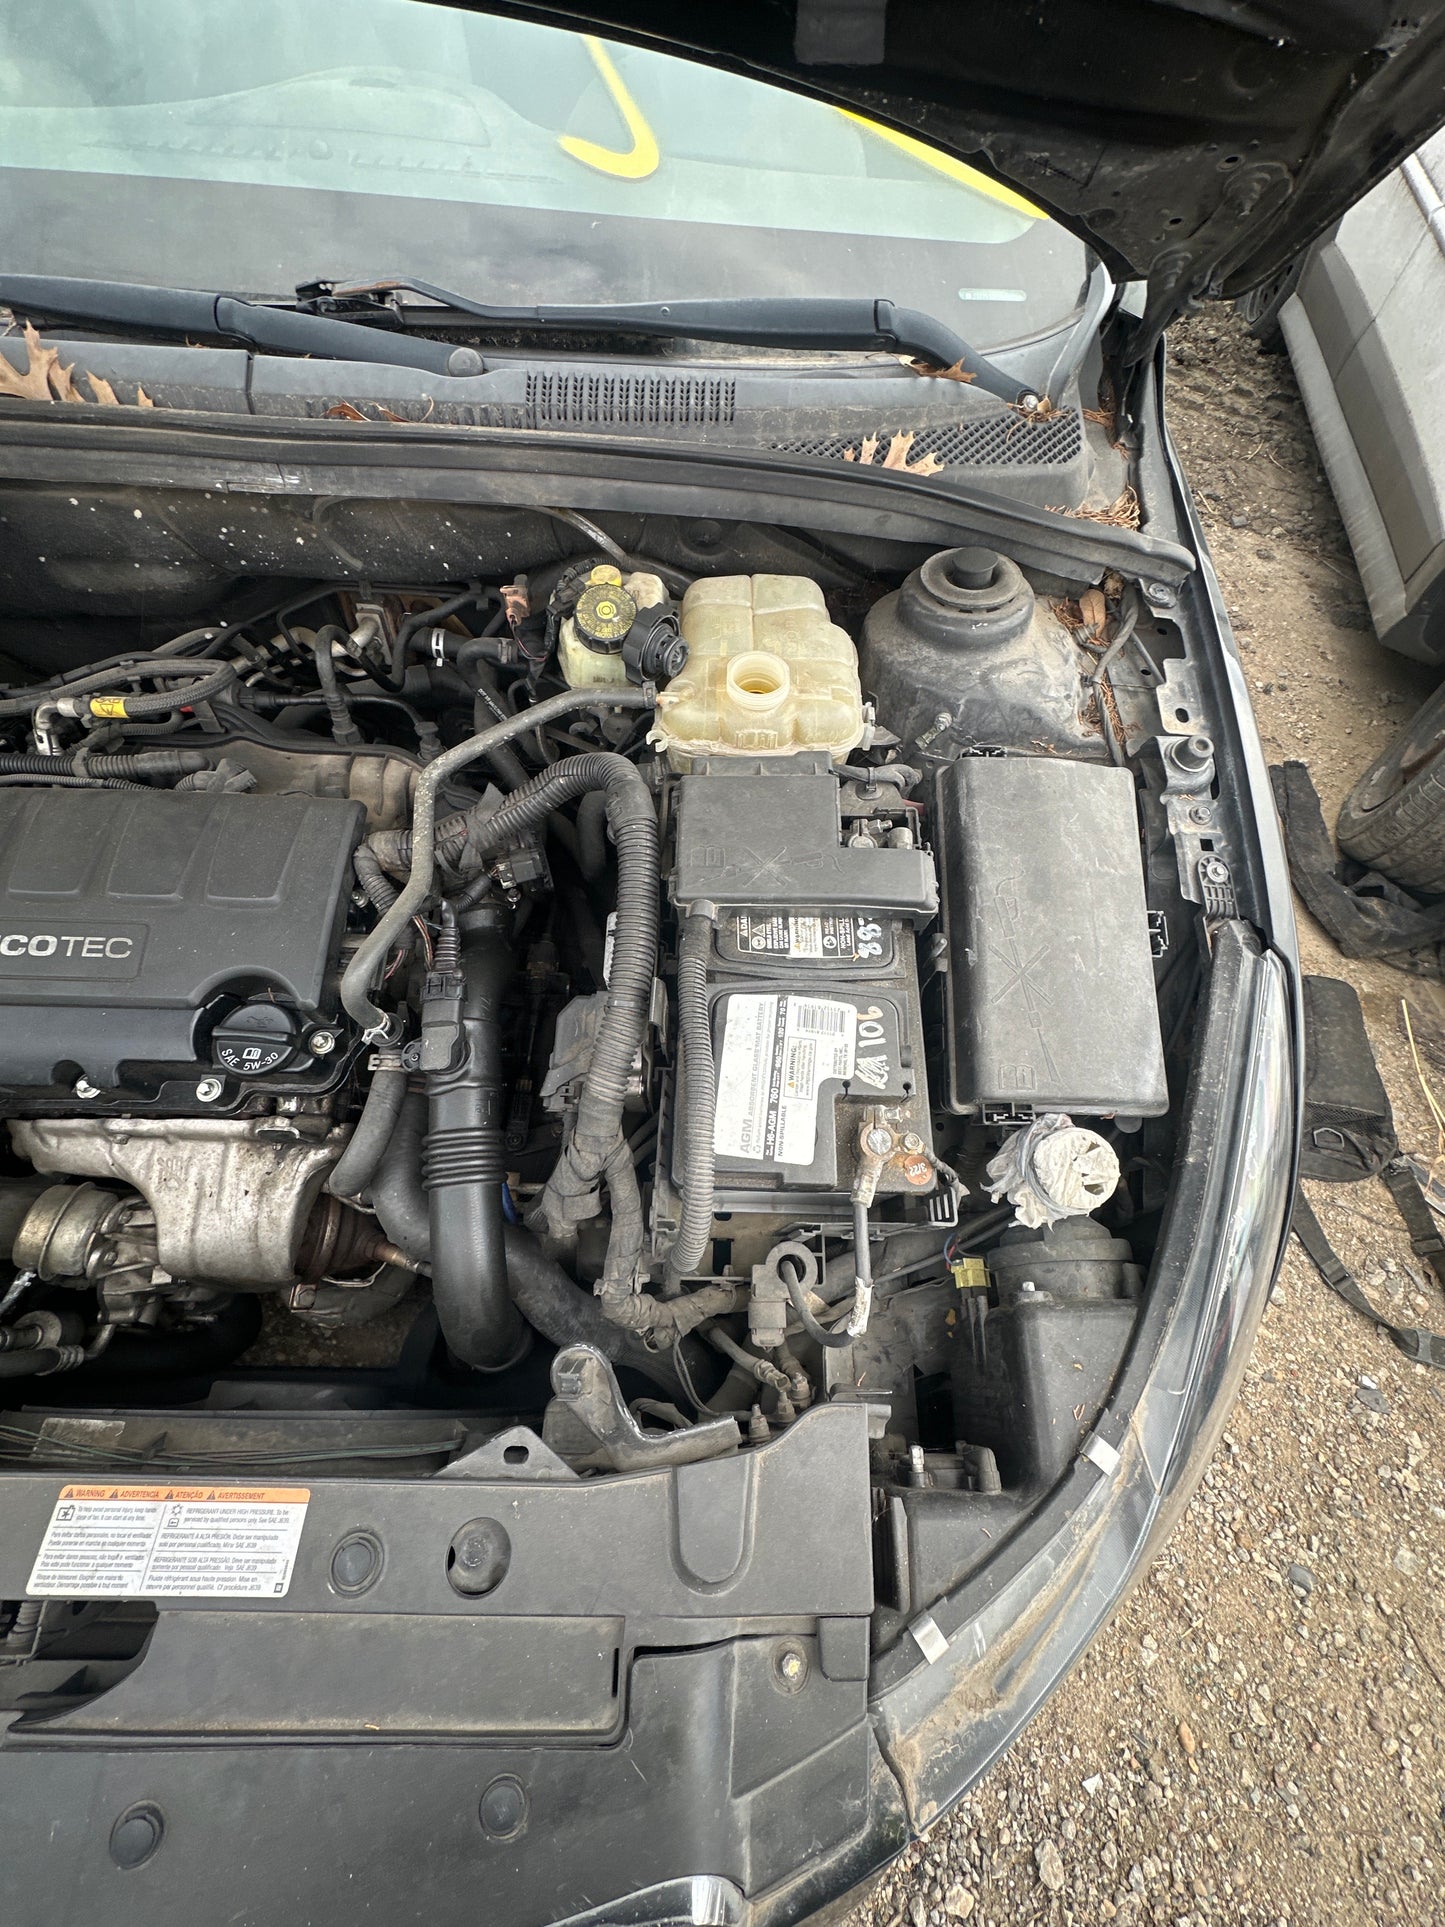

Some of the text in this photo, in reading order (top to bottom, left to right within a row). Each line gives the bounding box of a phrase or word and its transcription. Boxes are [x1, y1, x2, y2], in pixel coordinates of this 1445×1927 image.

[0, 934, 133, 959] COTEC
[221, 1048, 278, 1071] SAE 5W-30
[788, 1045, 797, 1080] WARNING:
[740, 1118, 753, 1154] AGM
[748, 1073, 758, 1116] ABSORBENT
[756, 1002, 764, 1031] BATTERY
[766, 1110, 777, 1145] H6-AGM
[778, 1105, 787, 1156] NON-SPILLABLE
[908, 1162, 928, 1178] 3/22
[76, 1489, 105, 1498] WARNING
[120, 1490, 159, 1498] ADVERTENCIA
[175, 1491, 204, 1500] ATENÇÃO
[217, 1492, 265, 1500] AVERTISSEMENT
